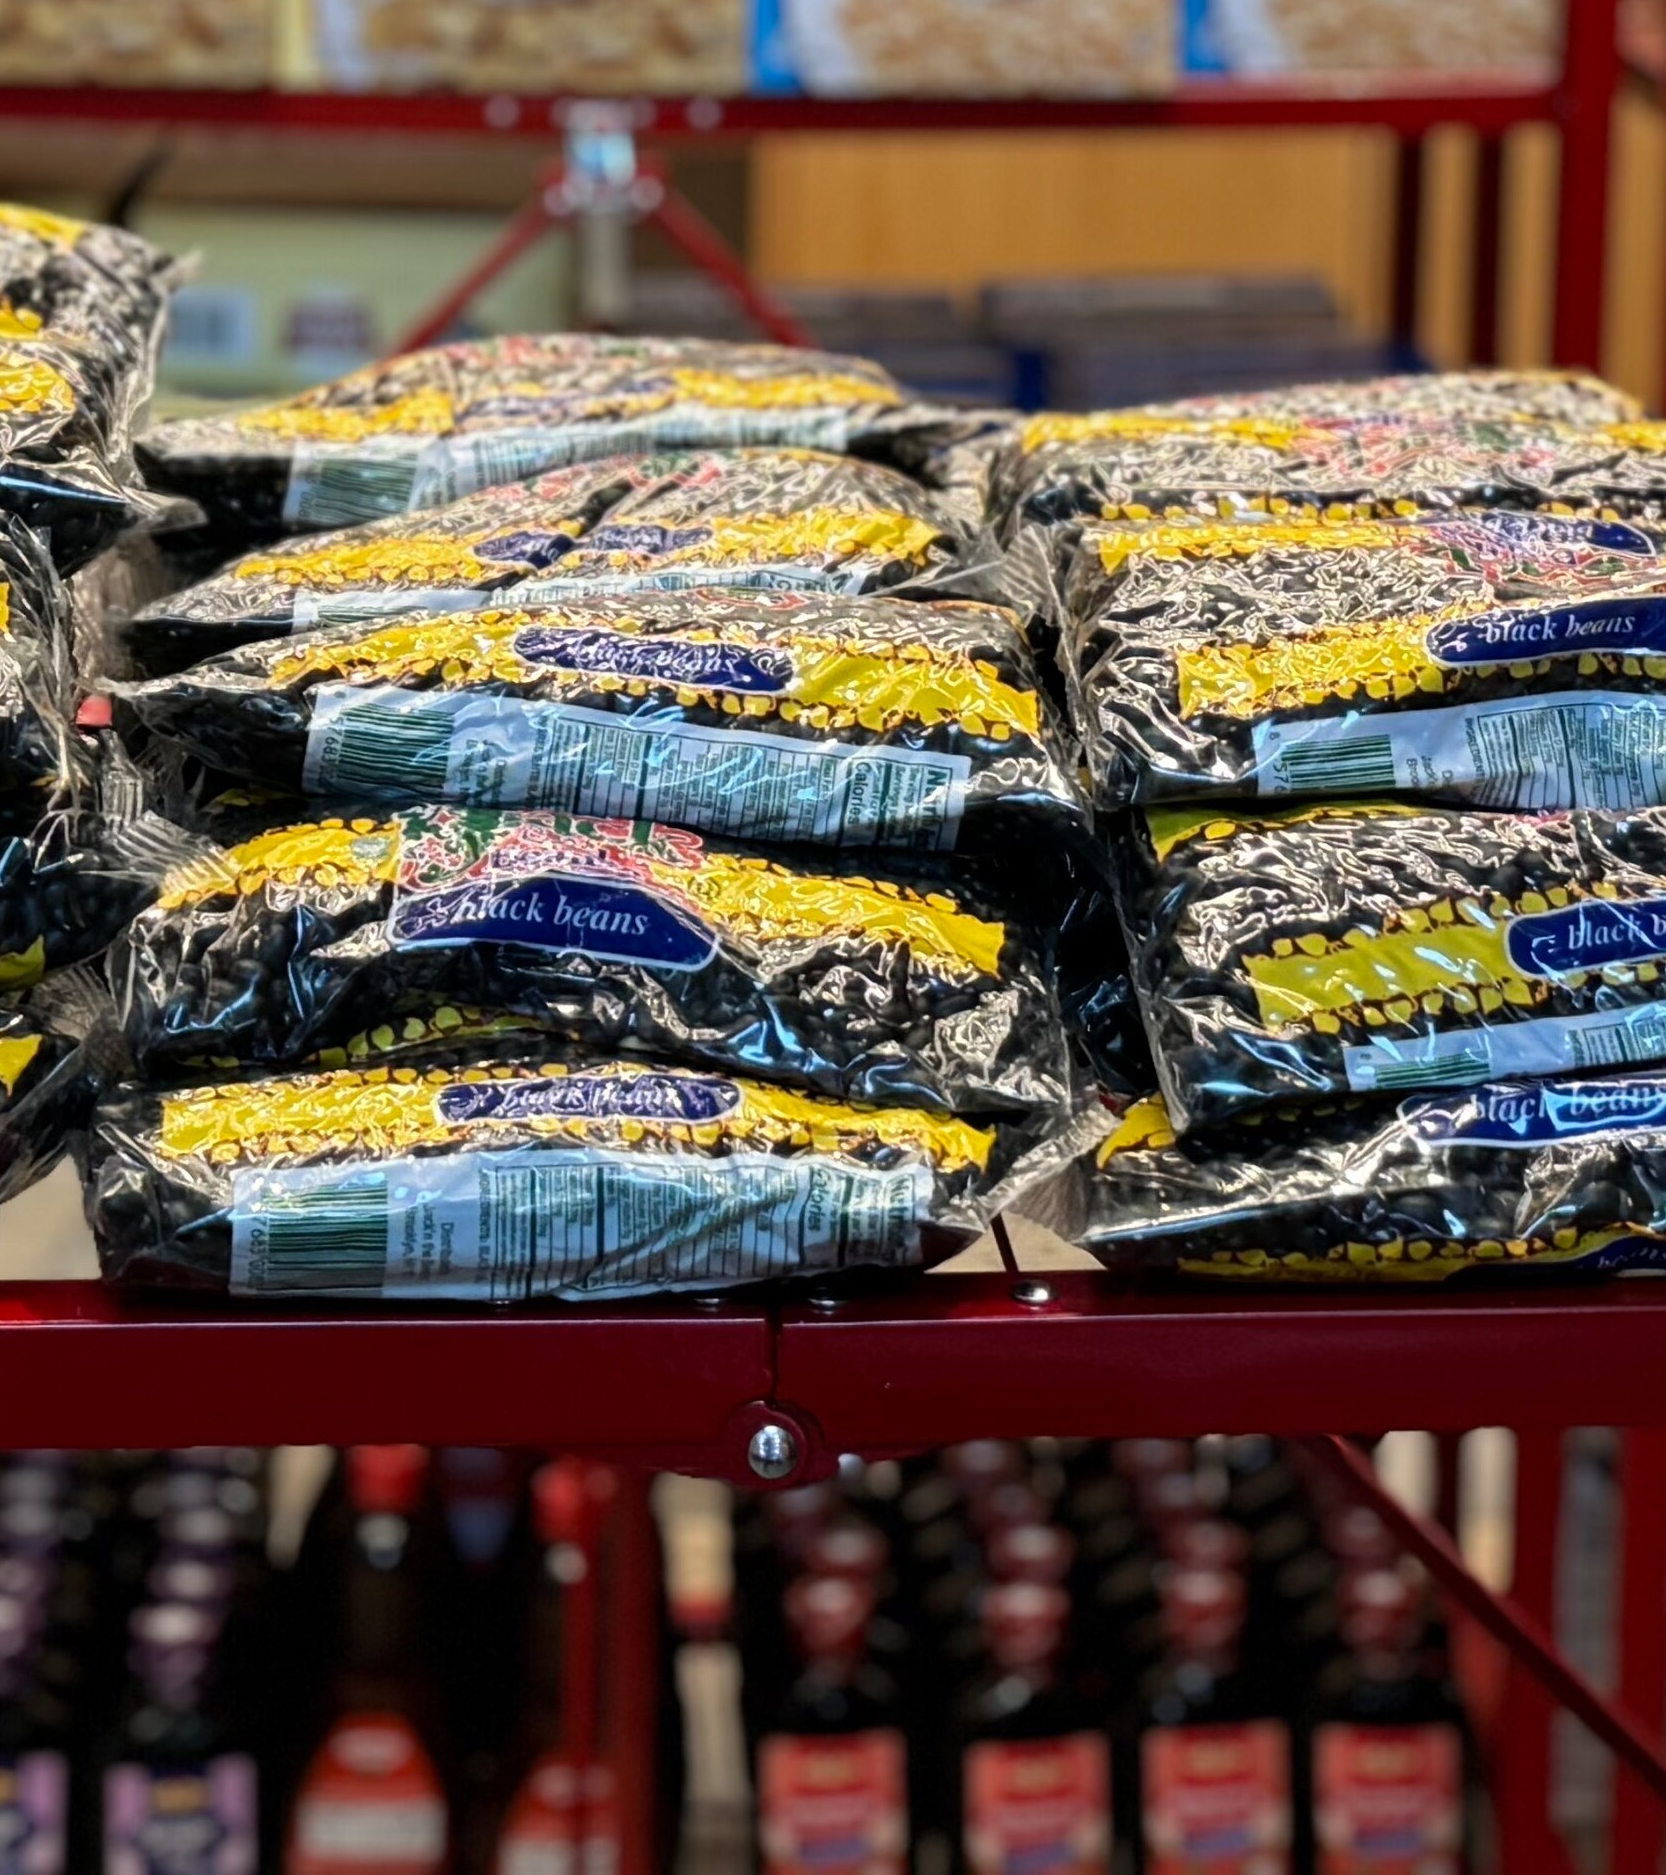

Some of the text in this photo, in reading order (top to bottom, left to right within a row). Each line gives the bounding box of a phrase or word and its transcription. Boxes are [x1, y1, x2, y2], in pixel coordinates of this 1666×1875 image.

[1484, 613, 1636, 644] black beans
[847, 761, 870, 825] Calories
[552, 896, 650, 937] beans
[1568, 919, 1643, 950] black
